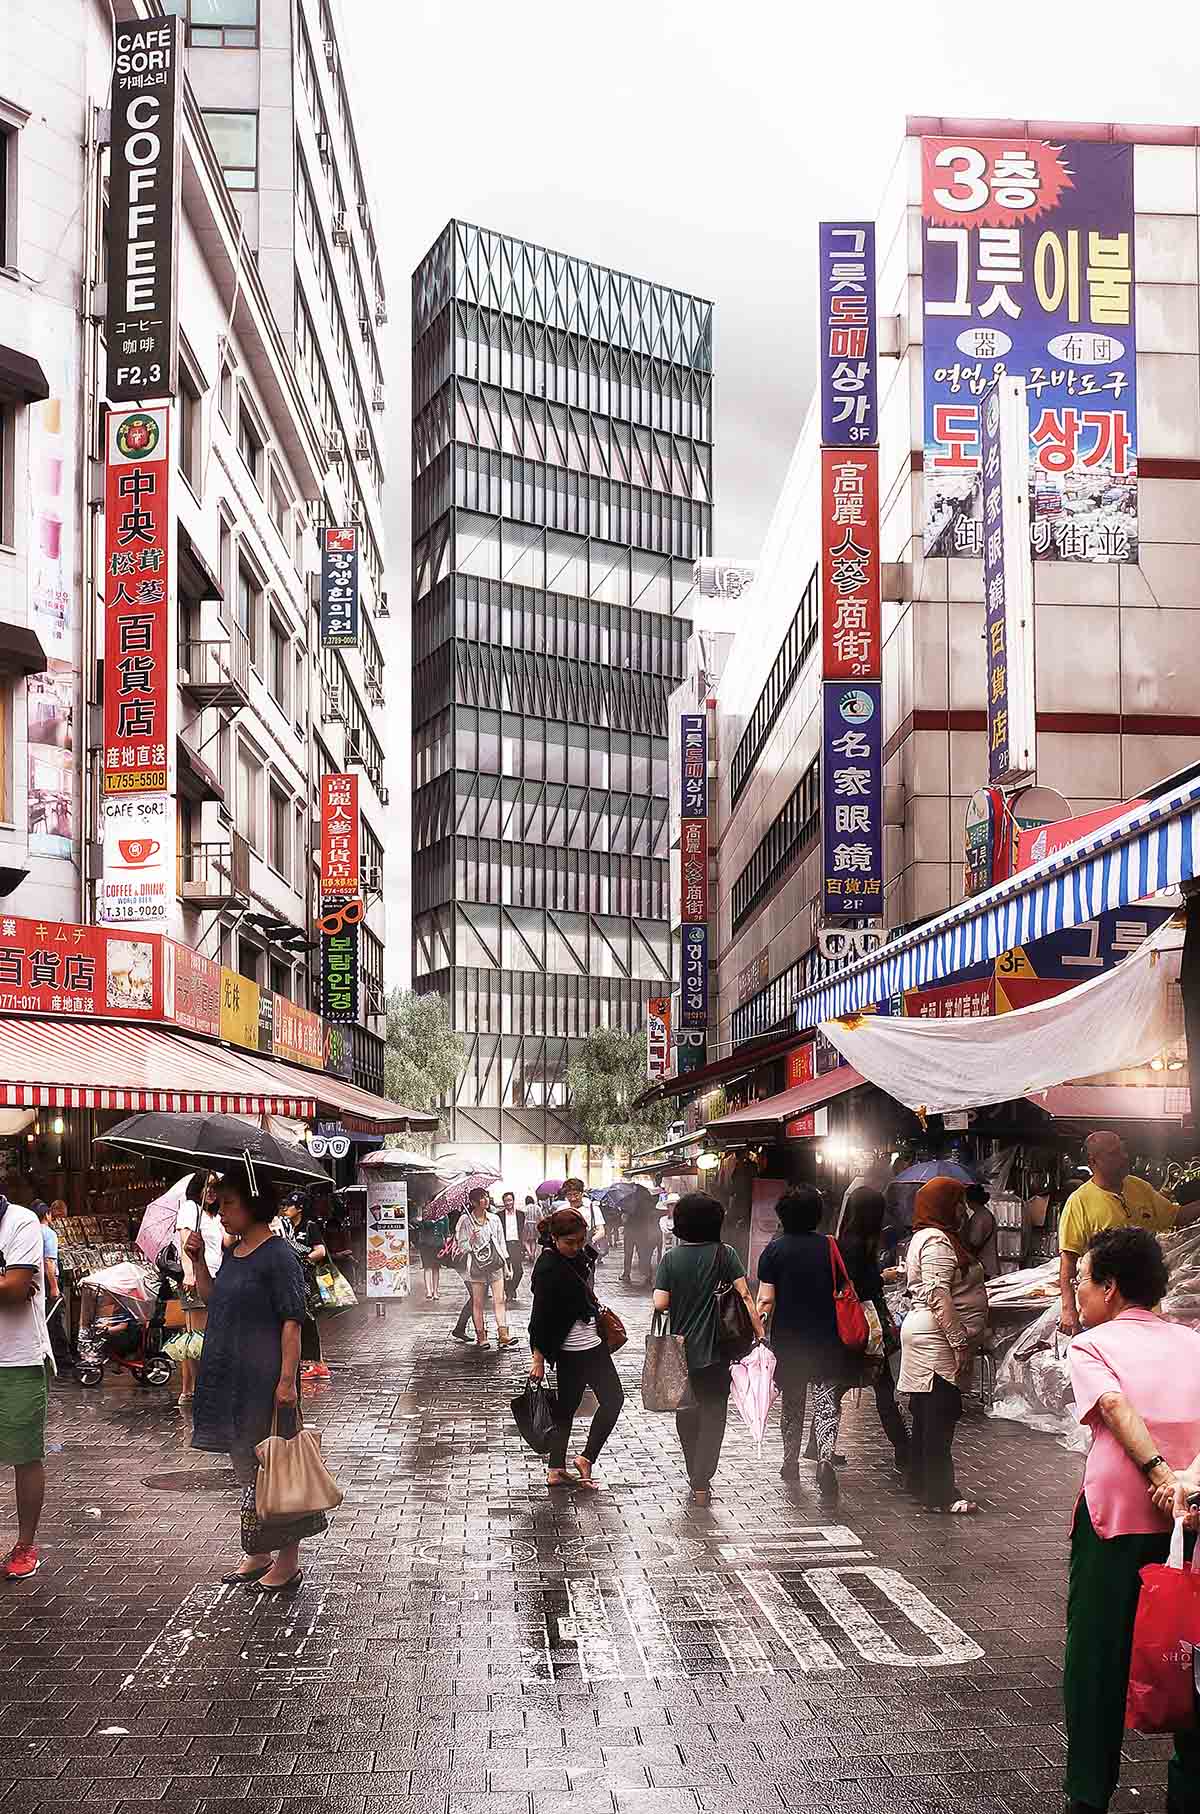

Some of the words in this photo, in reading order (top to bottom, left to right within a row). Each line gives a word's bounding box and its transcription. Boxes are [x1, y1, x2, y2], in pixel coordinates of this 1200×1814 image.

[117, 24, 171, 52] CAFÉ
[117, 49, 170, 75] SORI
[119, 72, 168, 90] 카페소리
[933, 146, 1040, 212] 3층
[124, 96, 161, 313] COFFEE
[116, 320, 163, 334] コーヒー
[974, 332, 995, 357] 器
[1062, 335, 1111, 361] 布団
[116, 364, 162, 386] F2,3
[849, 427, 871, 441] 3F
[851, 664, 871, 676] 2F
[106, 744, 165, 768] 産地直送
[107, 772, 165, 789] T.755-5508
[832, 730, 873, 872] 名家眼鏡
[106, 884, 132, 898] COFFEE
[826, 879, 881, 895] 百貨店
[106, 906, 164, 918] T.318-9020
[843, 899, 864, 910] 2F
[35, 923, 86, 945] キムチ
[1000, 951, 1025, 973] 3F
